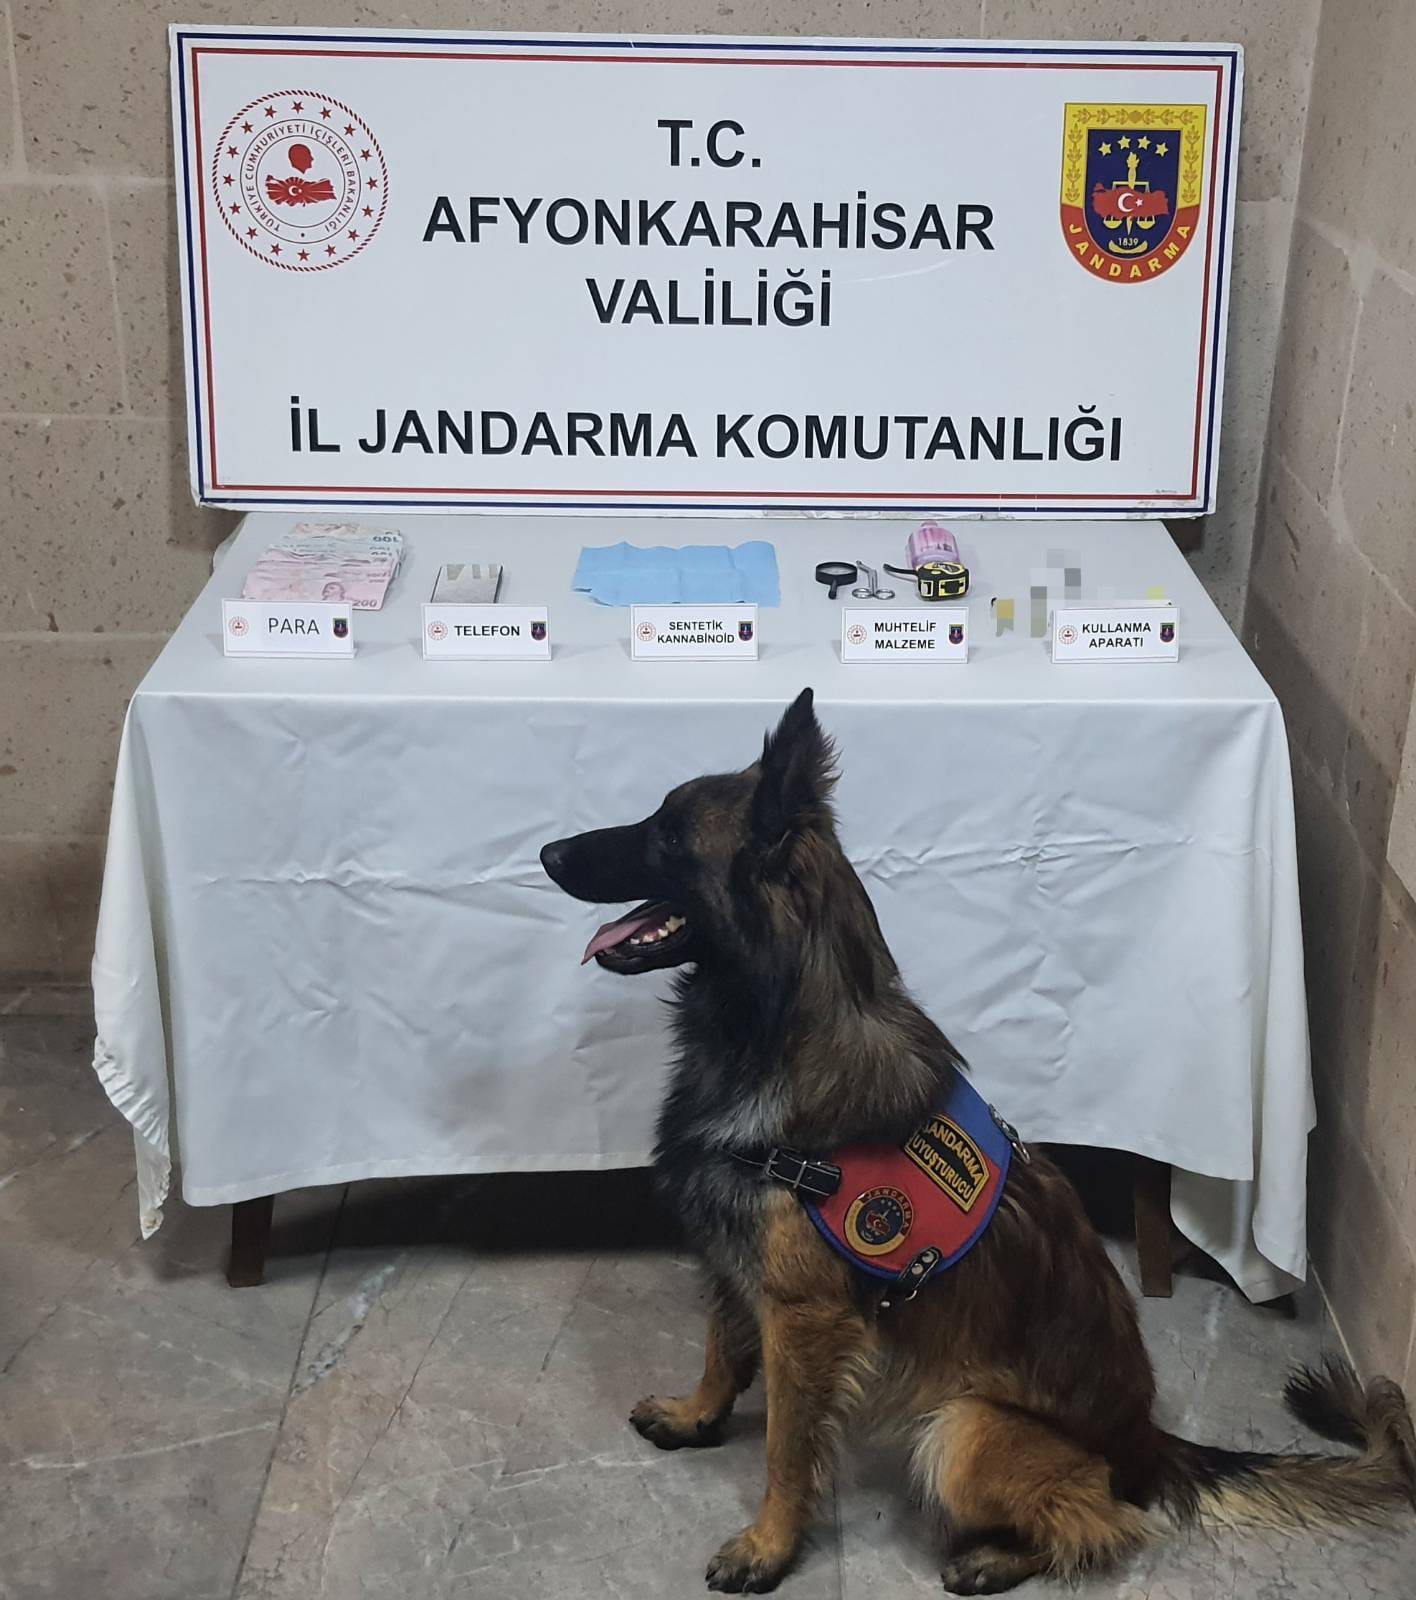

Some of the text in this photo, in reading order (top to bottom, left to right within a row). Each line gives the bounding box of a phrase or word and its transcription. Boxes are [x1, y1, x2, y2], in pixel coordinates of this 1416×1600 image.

[245, 122, 306, 181] CUMHURİYETİ
[310, 124, 354, 166] İÇİŞLERİ
[658, 119, 761, 168] T.C.
[324, 170, 356, 233] BAKANLIĞI
[423, 190, 995, 251] AFYONKARAHİSAR
[1069, 223, 1191, 279] JANDARMA
[1117, 237, 1139, 247] 1839
[585, 267, 831, 327] VALİLİĞİ
[291, 395, 1122, 462] İL JANDARMA KOMUTANLIĞI
[352, 599, 377, 608] 200
[268, 617, 321, 636] PARA
[454, 625, 521, 638] TELEFON
[669, 619, 723, 631] SENTETİK
[874, 620, 937, 633] MUHTELİF
[1082, 622, 1152, 634] KULLANMA
[657, 632, 735, 644] KANNABİNOİD
[874, 638, 936, 650] MALZEME
[1088, 637, 1144, 648] APARATI
[912, 1135, 974, 1200] UYUŞTURUCU
